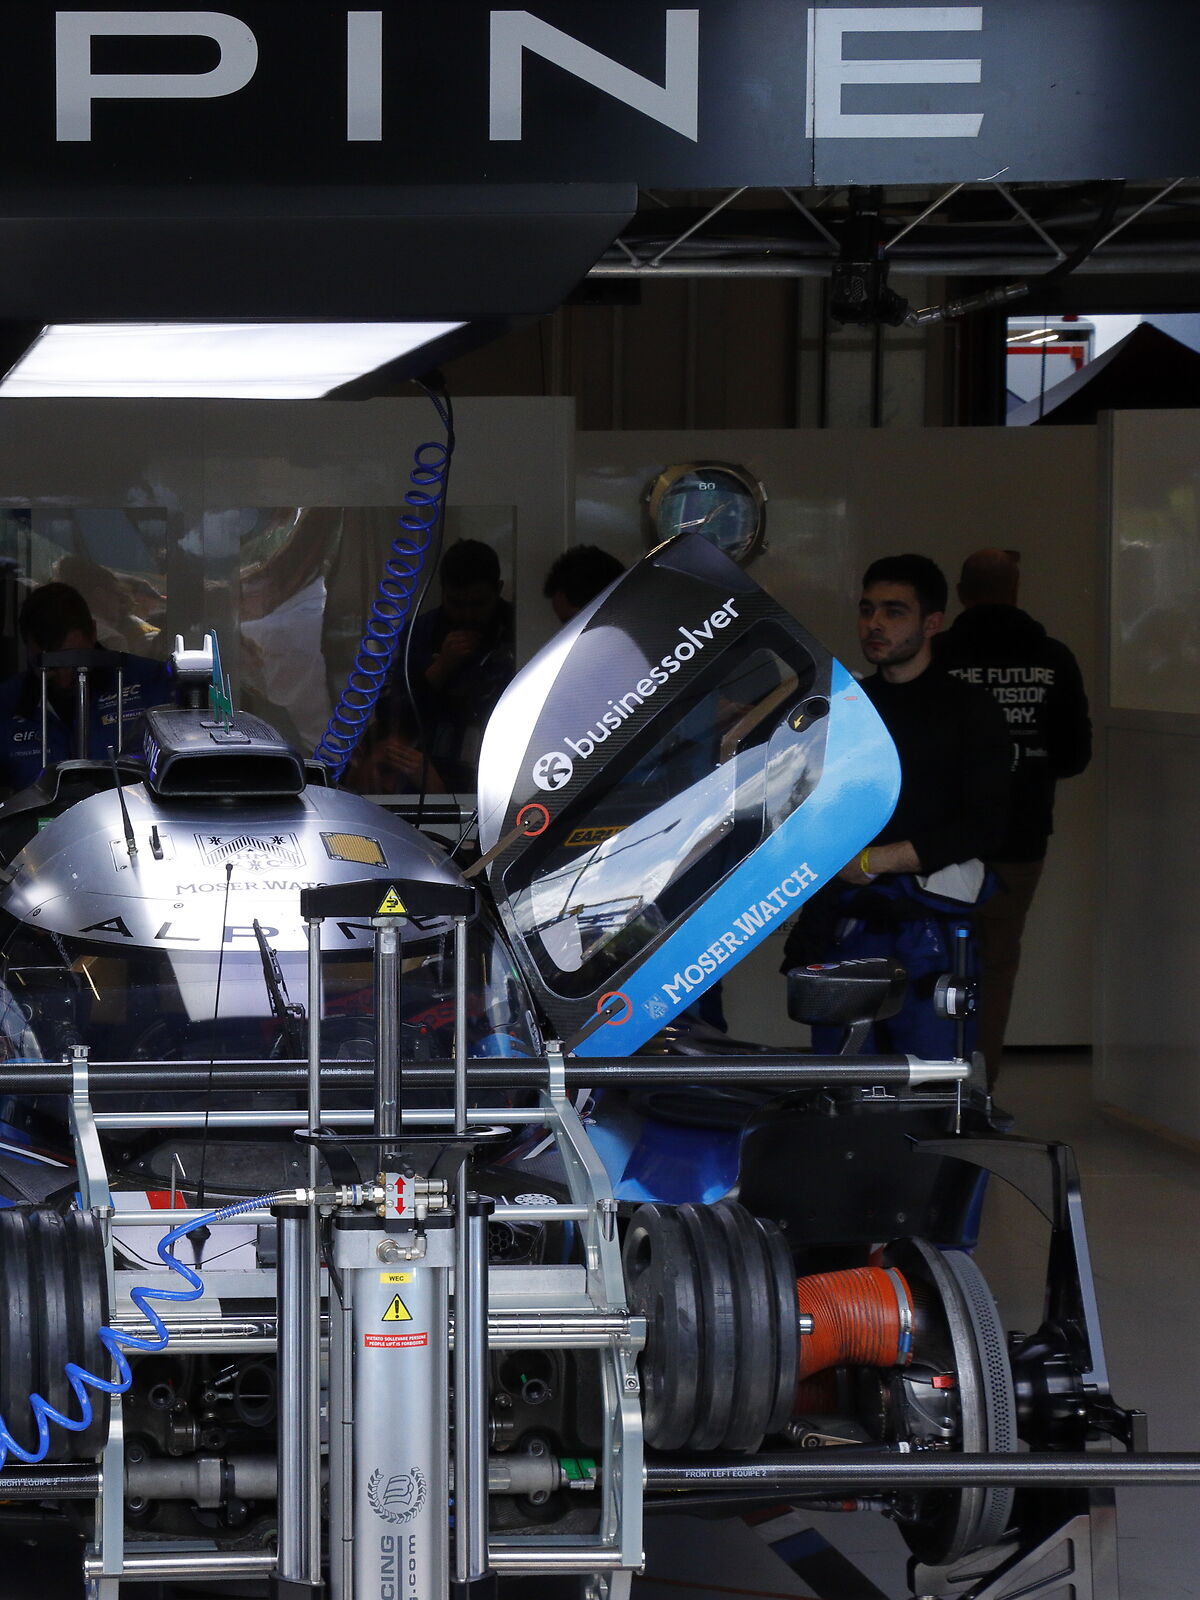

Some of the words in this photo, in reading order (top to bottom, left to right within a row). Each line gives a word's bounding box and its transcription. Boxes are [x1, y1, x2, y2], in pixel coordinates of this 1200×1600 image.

[563, 597, 739, 759] businessolver
[987, 667, 1055, 685] FUTURE
[13, 731, 35, 742] elf
[79, 915, 449, 944] ALPNE
[661, 862, 819, 1004] MOSER.WATCH
[23, 1478, 51, 1487] EQUIPE
[685, 1470, 710, 1478] FRONT
[712, 1470, 730, 1478] LEFT
[732, 1469, 760, 1478] EQUIPE
